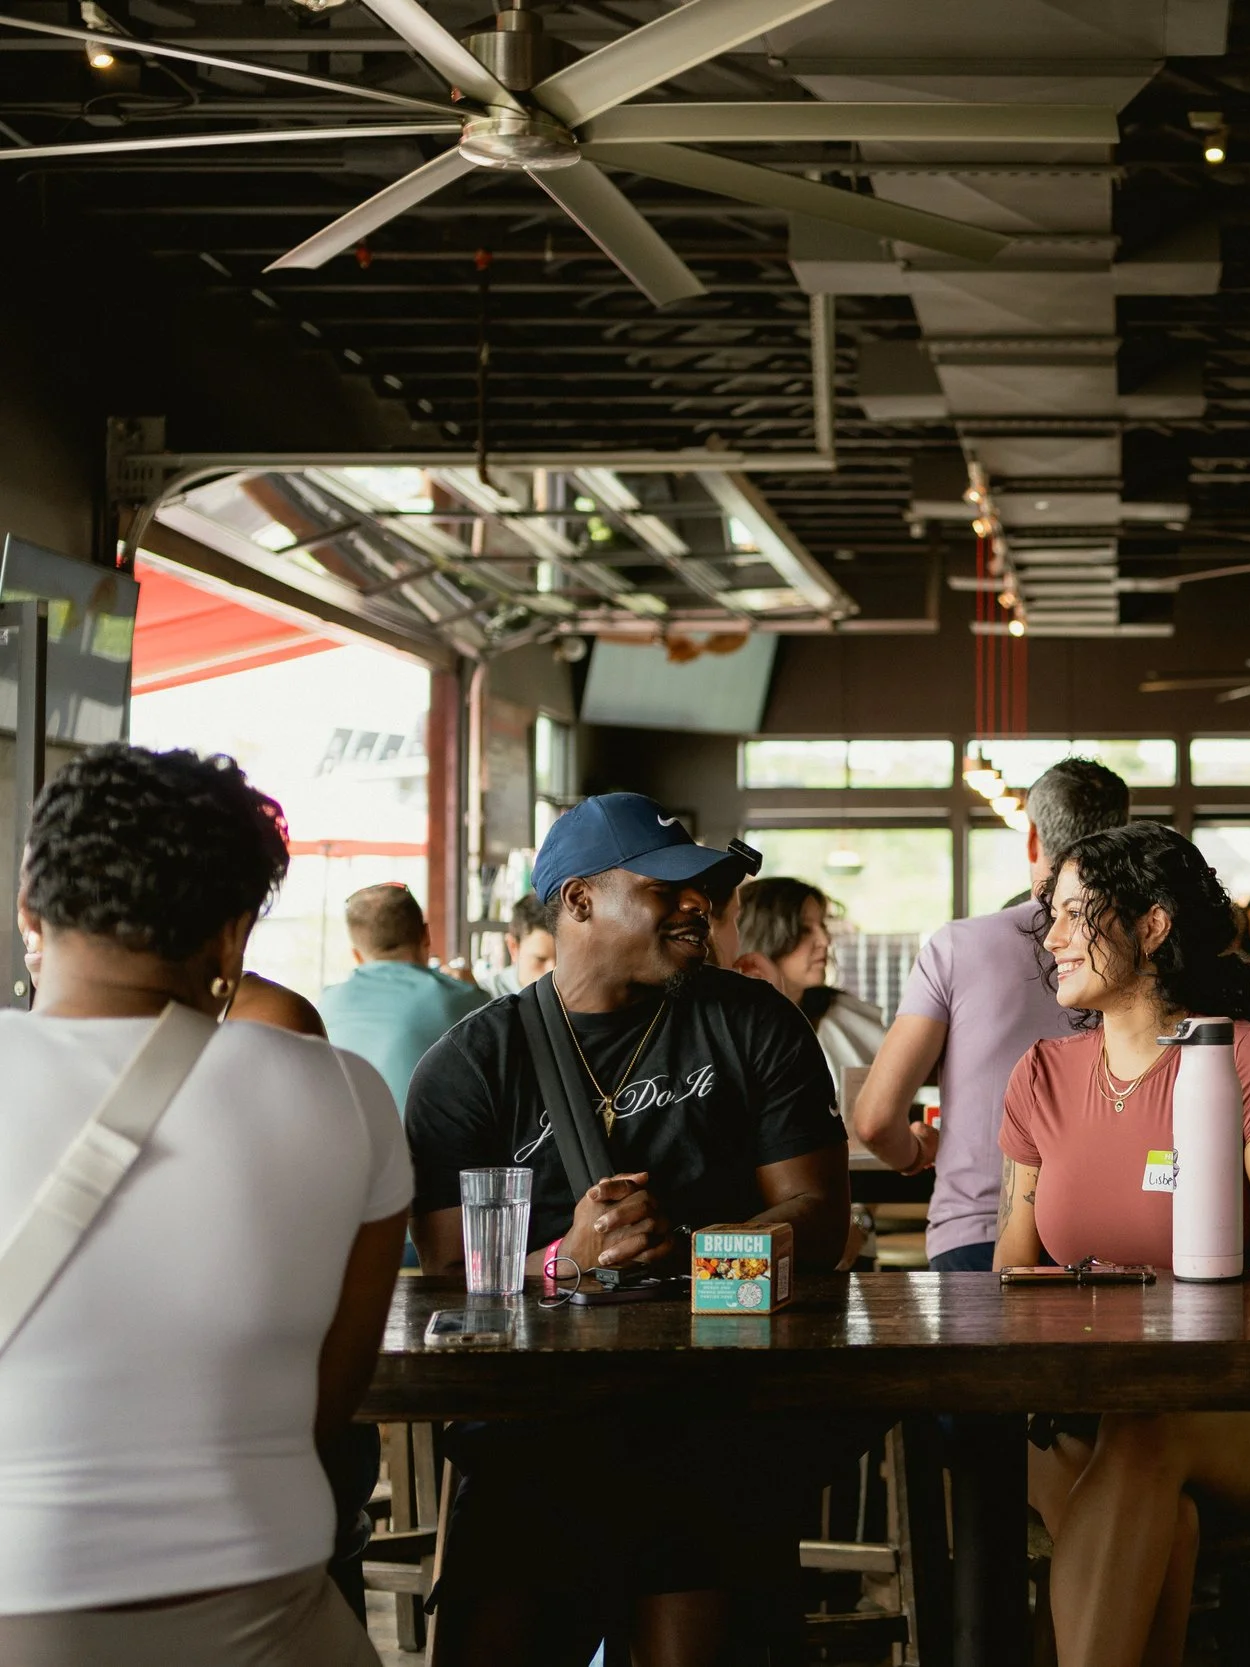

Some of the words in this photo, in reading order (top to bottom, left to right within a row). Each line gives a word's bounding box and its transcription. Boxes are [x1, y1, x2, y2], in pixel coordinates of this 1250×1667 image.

[613, 1074, 676, 1120] Do
[674, 1064, 715, 1104] It
[704, 1234, 763, 1253] BRUNCH
